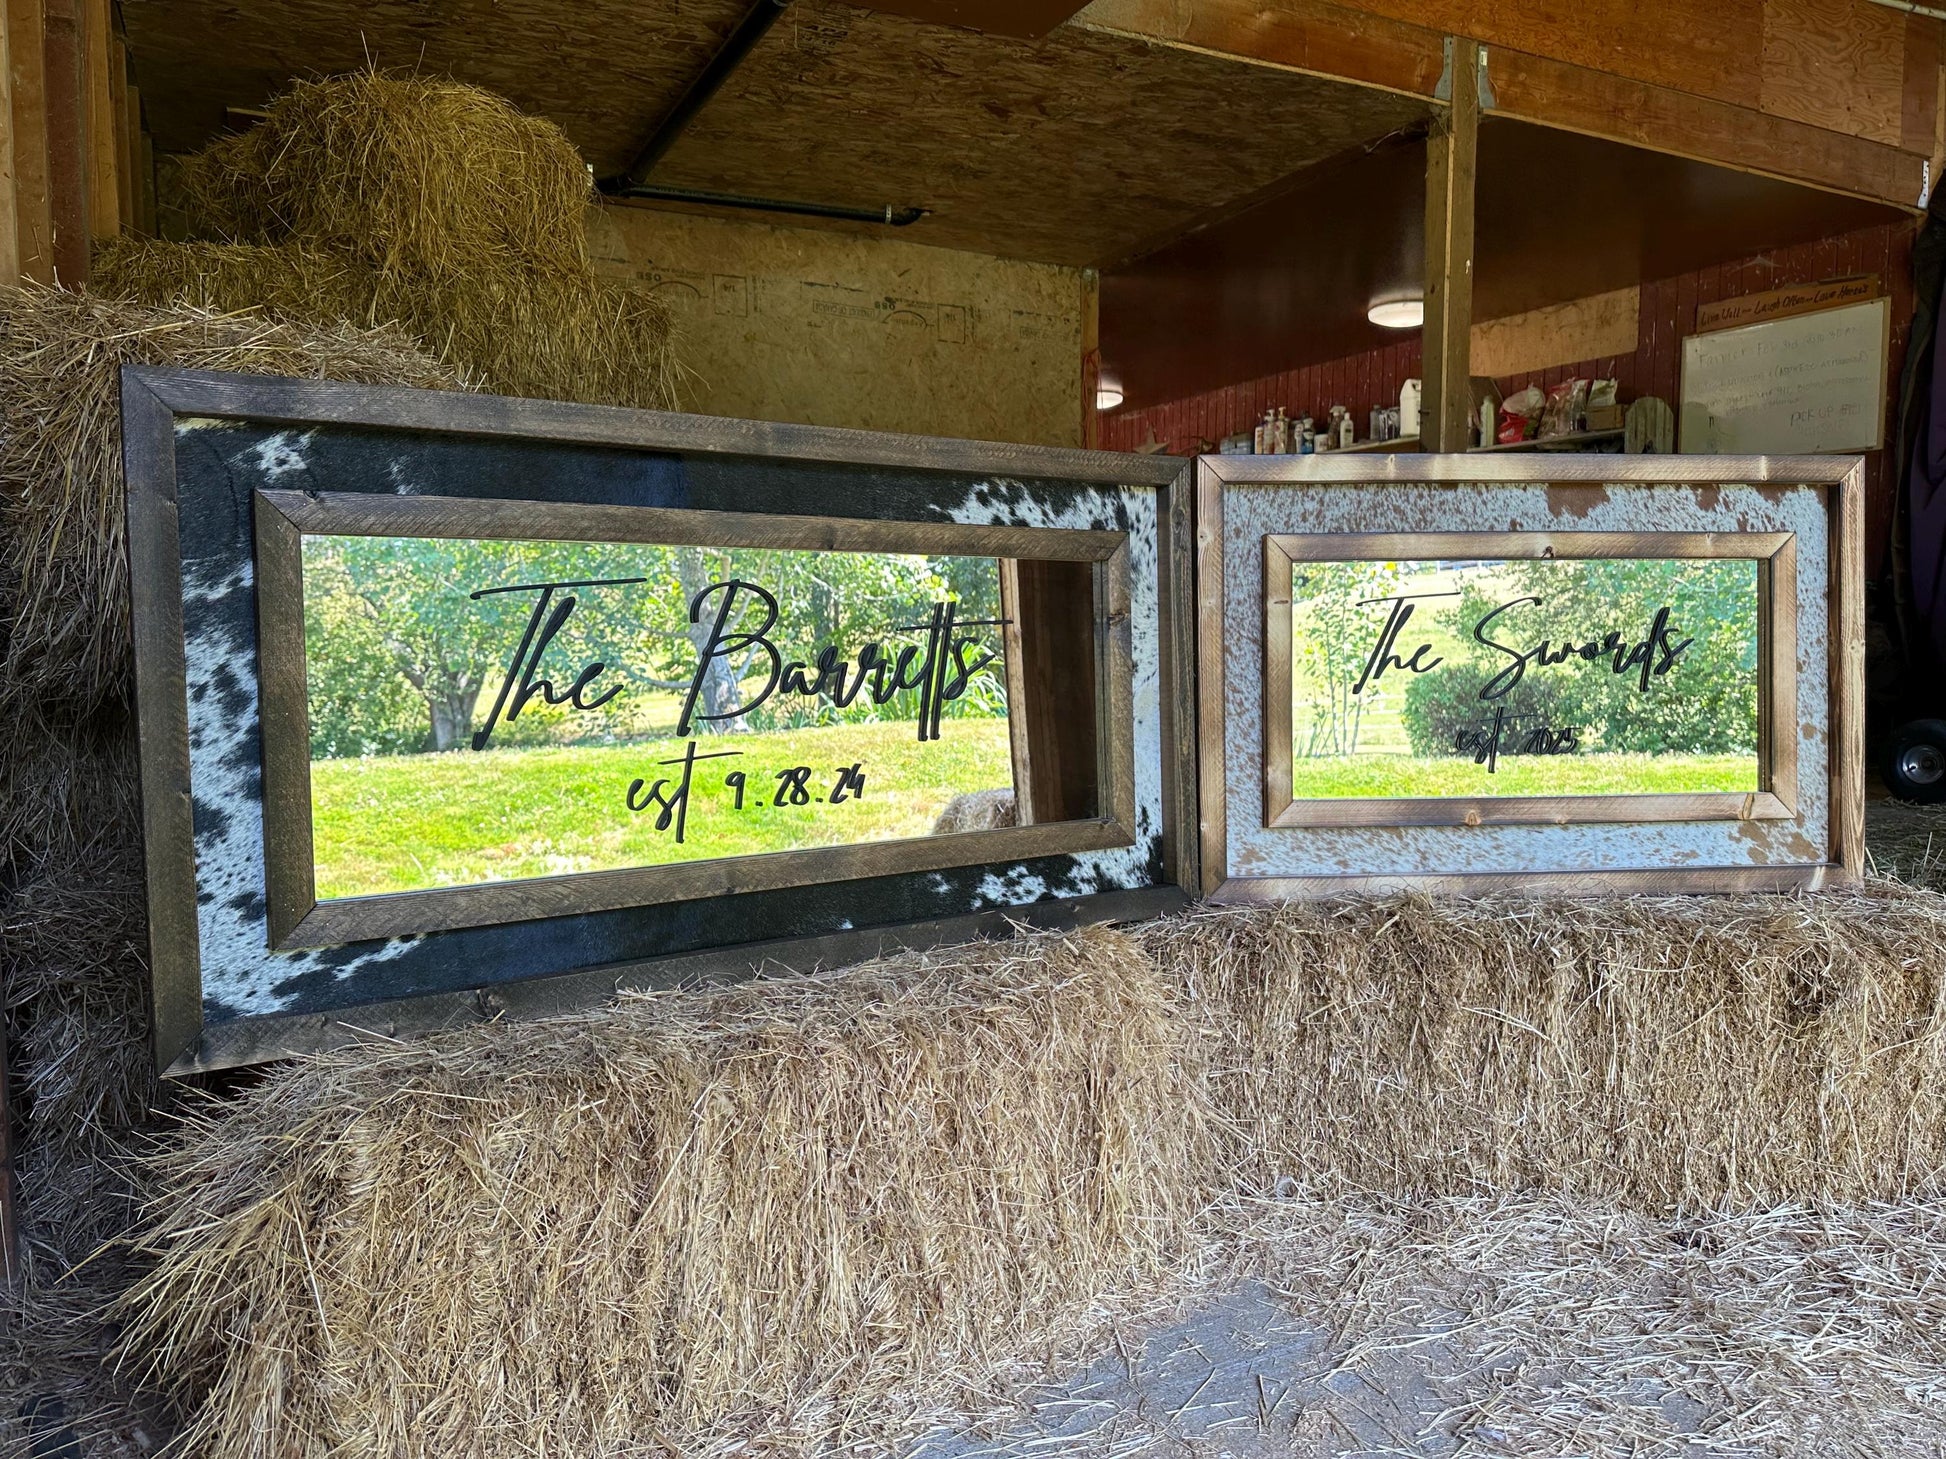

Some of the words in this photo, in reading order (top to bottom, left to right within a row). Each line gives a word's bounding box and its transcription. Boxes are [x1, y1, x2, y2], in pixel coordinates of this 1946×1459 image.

[469, 577, 647, 752] The
[676, 577, 1014, 742] Barretts
[1352, 591, 1461, 695] The
[1473, 596, 1696, 700] Swords
[626, 740, 744, 845] est
[1455, 706, 1538, 774] est
